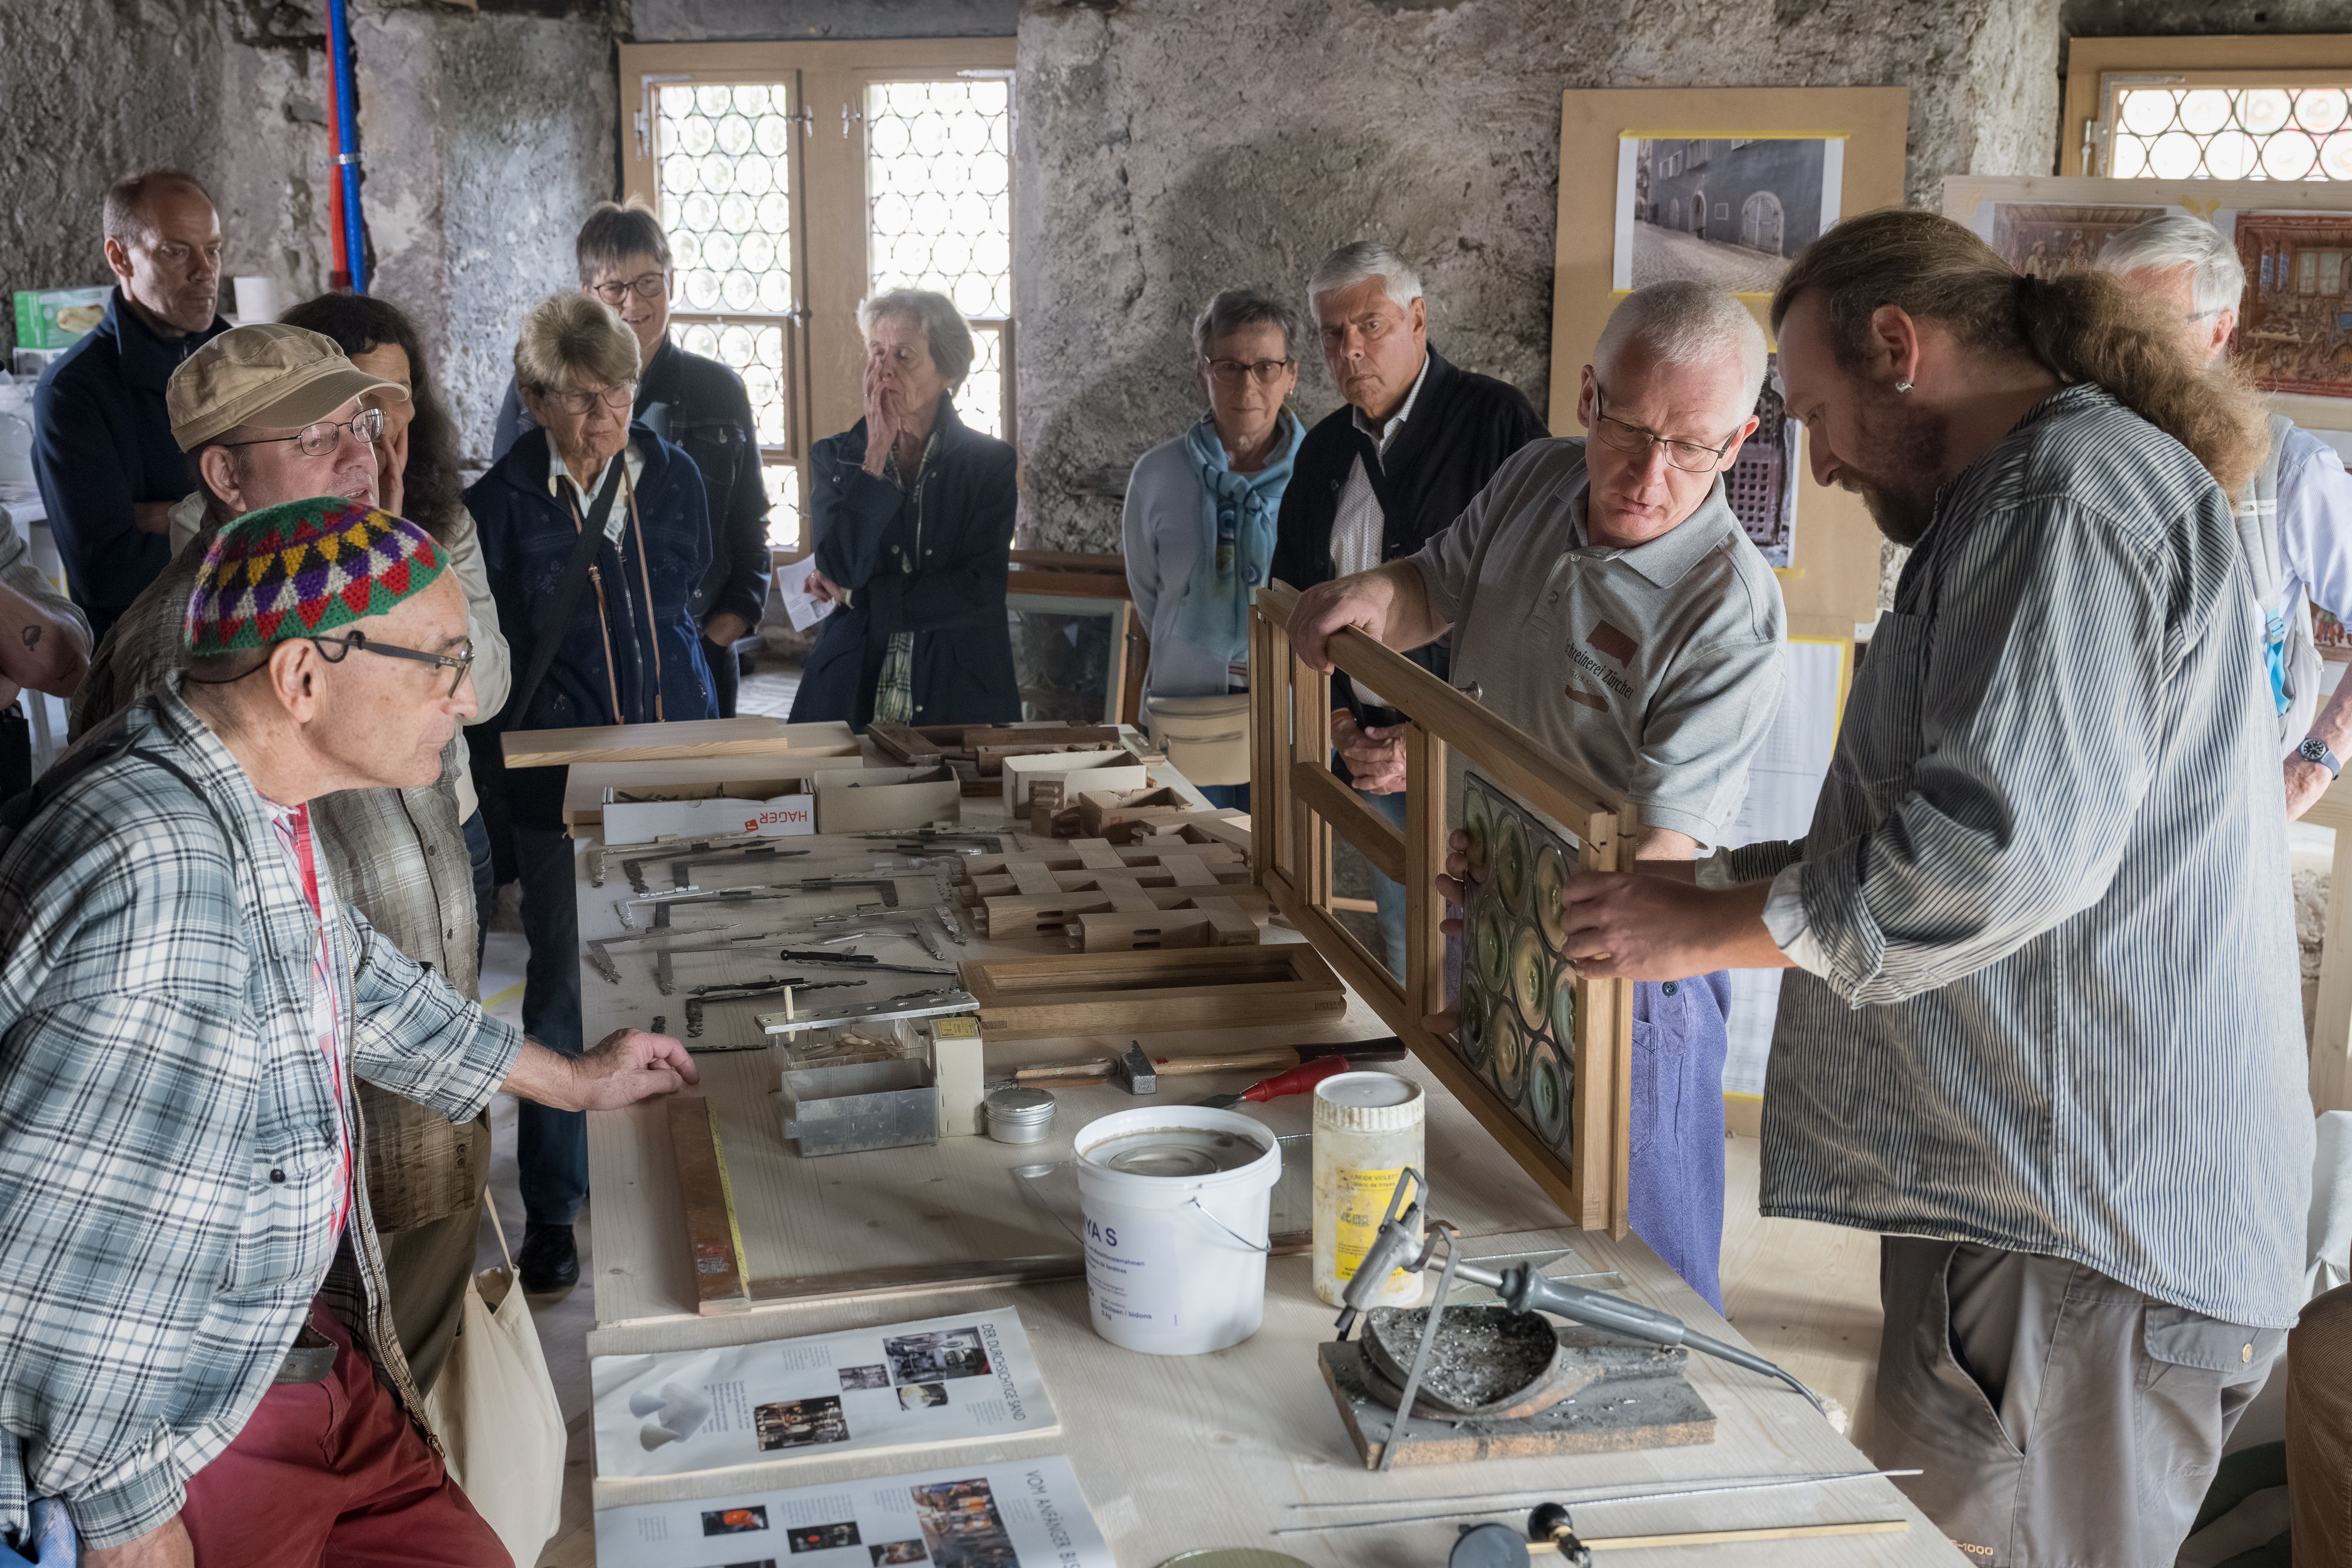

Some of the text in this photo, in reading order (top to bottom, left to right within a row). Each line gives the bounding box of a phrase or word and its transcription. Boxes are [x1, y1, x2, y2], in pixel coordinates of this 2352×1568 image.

[1601, 669, 1633, 699] Zürcher
[760, 811, 807, 824] HAGER
[1105, 1227, 1117, 1246] S
[1128, 1310, 1152, 1319] bidons
[981, 1323, 1026, 1422] DER DURCHSICHTIGE SAND
[1025, 1470, 1047, 1495] VOM
